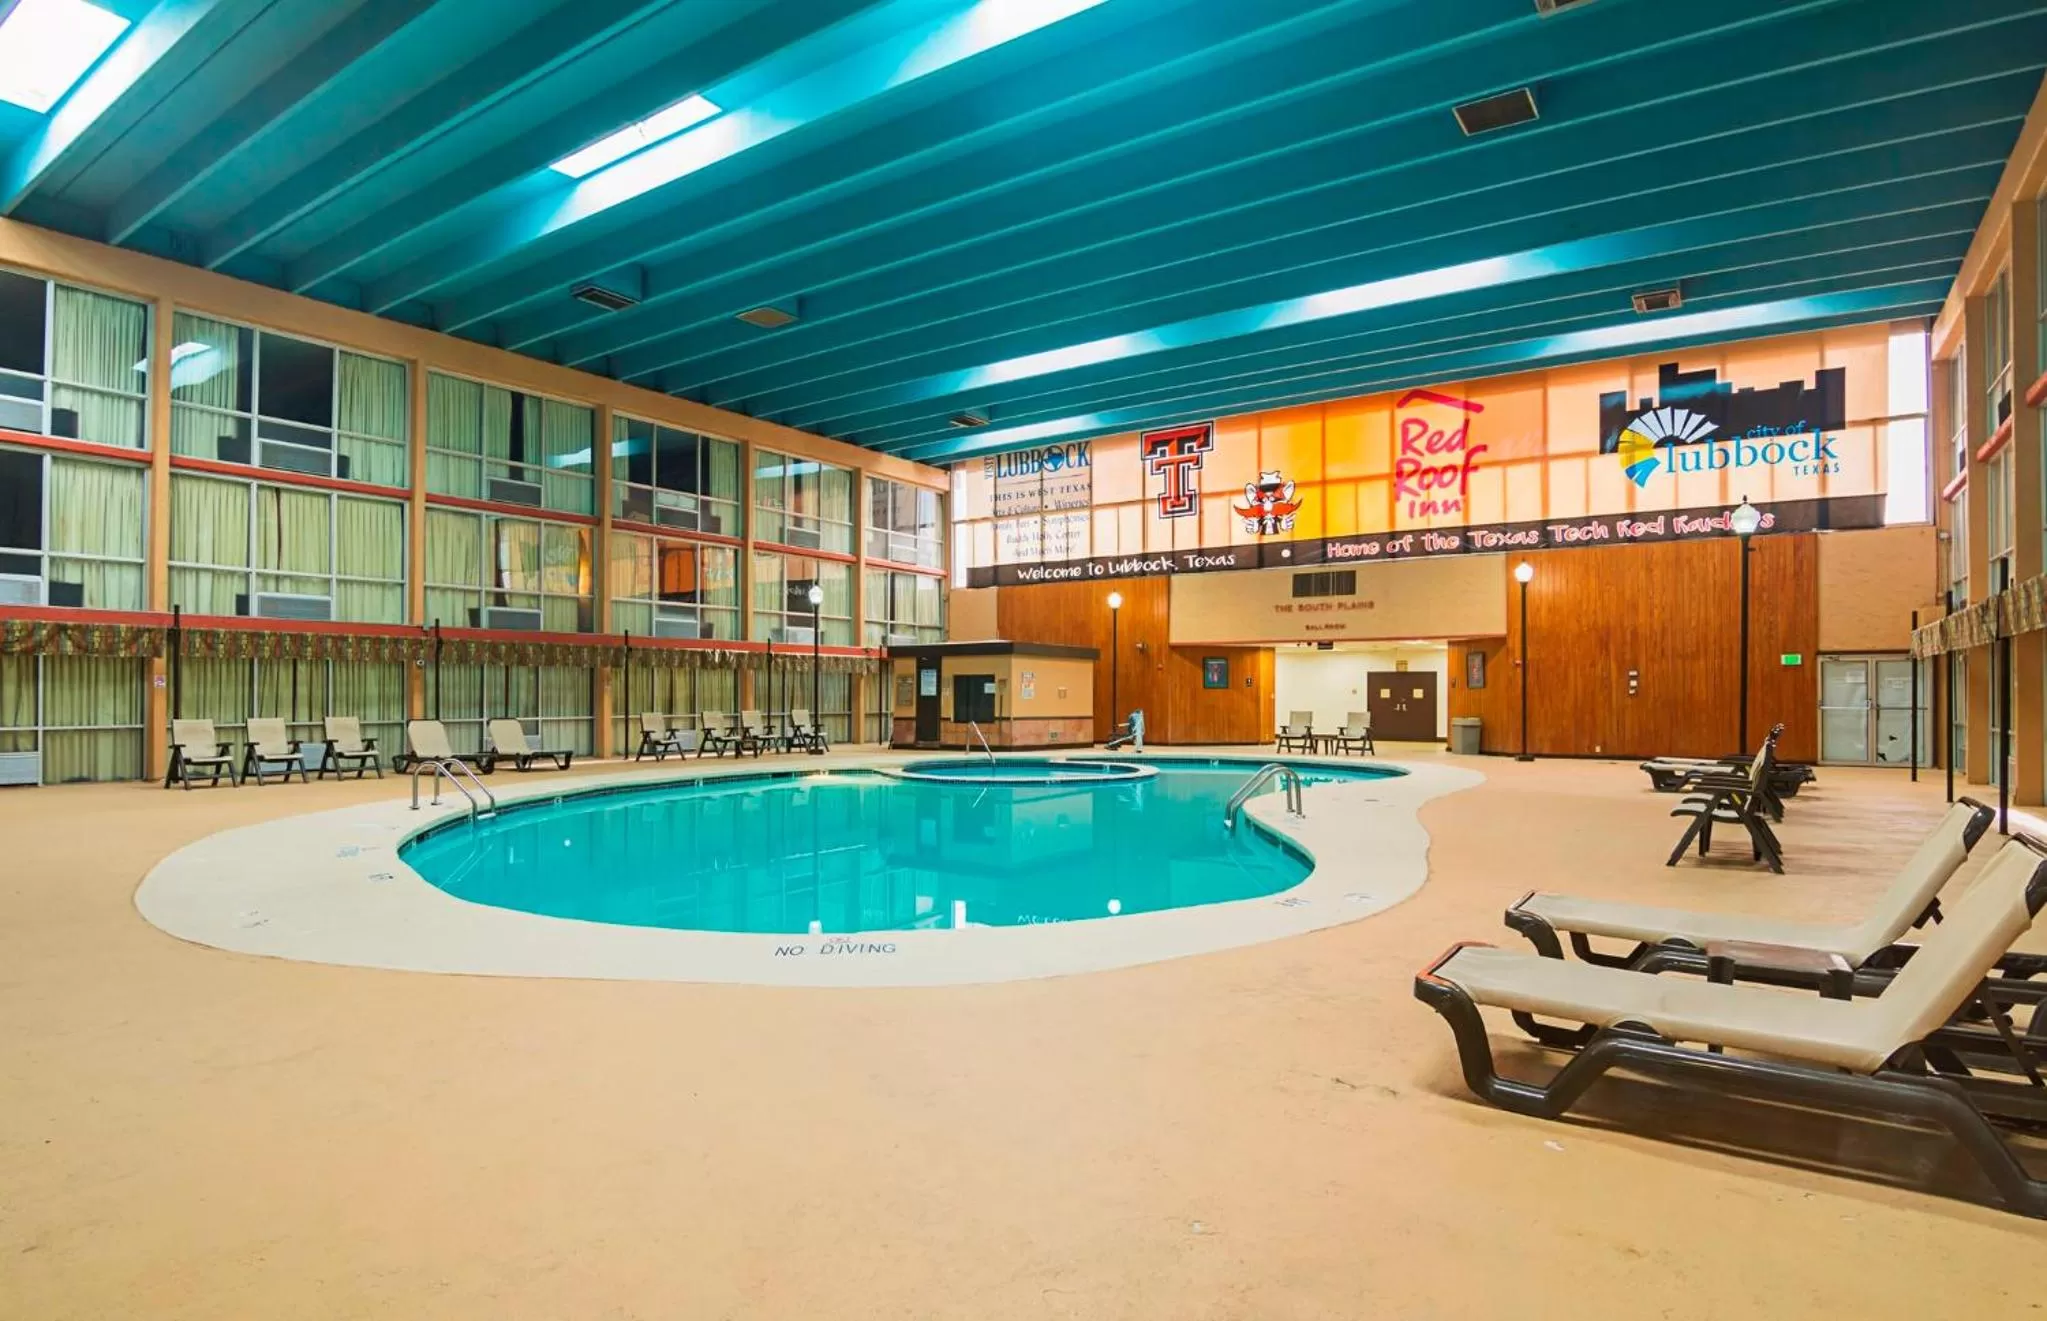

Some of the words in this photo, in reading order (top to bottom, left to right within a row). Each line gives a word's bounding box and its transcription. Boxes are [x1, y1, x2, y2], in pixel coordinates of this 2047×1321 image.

[1401, 418, 1470, 456] Red
[1746, 423, 1780, 439] city
[1785, 420, 1806, 435] of
[996, 441, 1091, 478] LUBBOCK
[1666, 428, 1838, 473] lubbock
[1396, 444, 1487, 502] Roof
[1793, 463, 1841, 476] TEXAS
[990, 493, 1012, 503] THIS
[1016, 491, 1026, 500] IS
[1028, 486, 1055, 498] WEST
[1060, 482, 1092, 494] TEXAS
[1327, 542, 1380, 559] Home
[1386, 534, 1413, 553] of
[1421, 532, 1460, 551] the
[1467, 530, 1539, 548] Texas
[1547, 520, 1609, 543] Tech
[1617, 515, 1665, 537] Red
[1673, 511, 1776, 535] Raids
[1017, 562, 1082, 580] Welcome
[1087, 561, 1104, 576] to
[1183, 553, 1236, 569] Texas
[1274, 604, 1293, 613] THE
[1298, 602, 1333, 612] SOUTH
[1337, 601, 1375, 610] PLAINS
[775, 945, 805, 956] NO
[820, 943, 897, 955] DIVING
